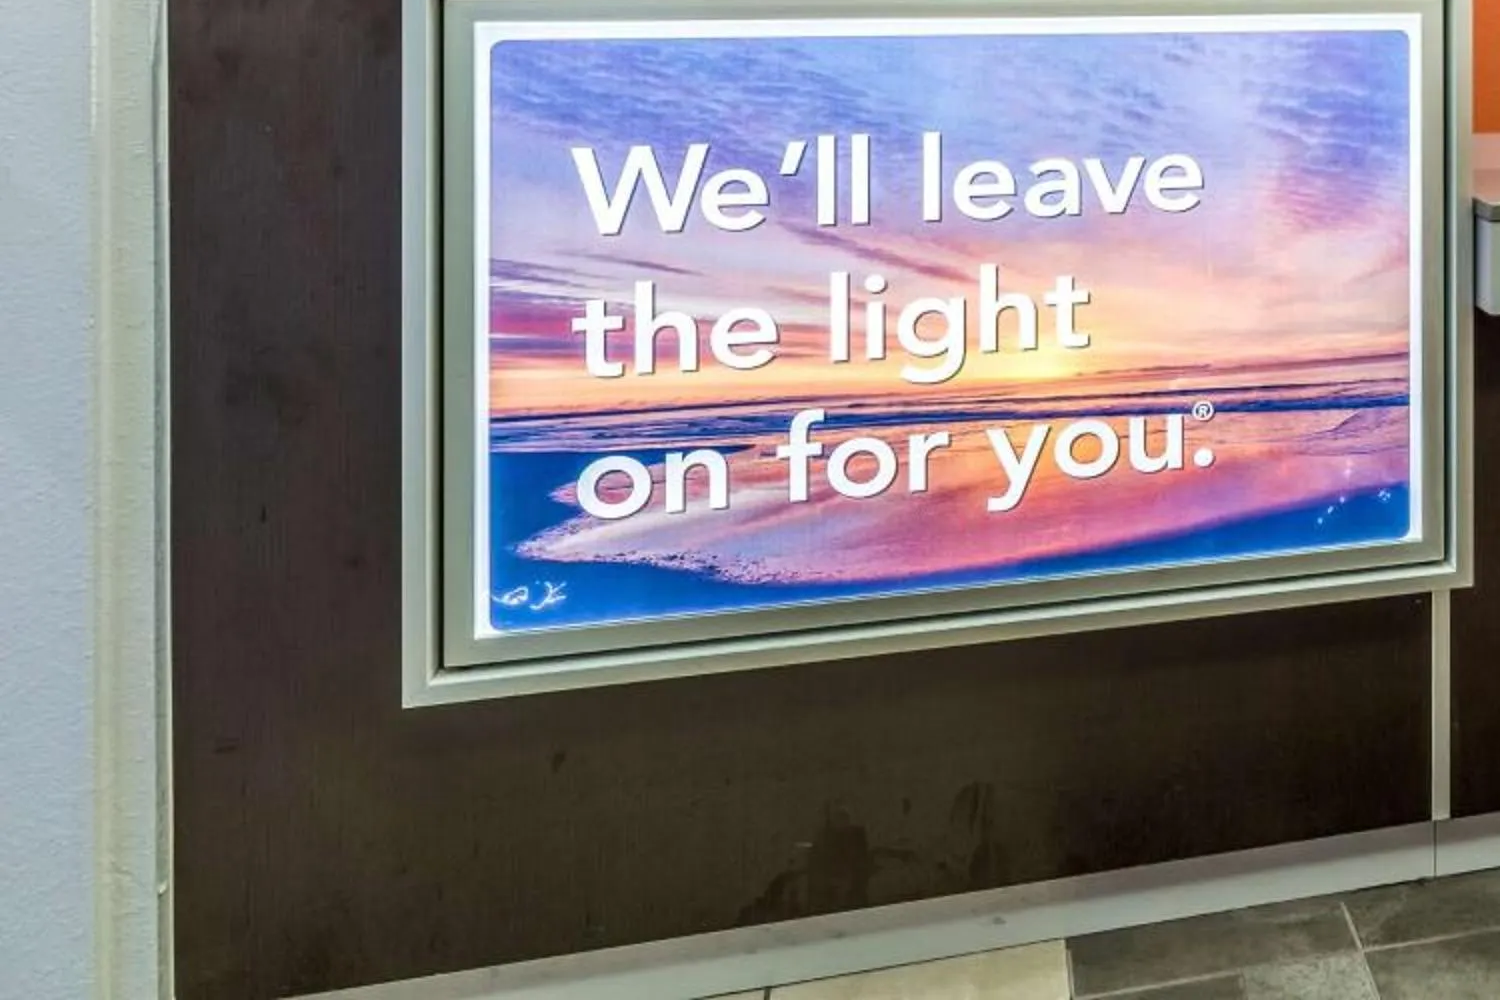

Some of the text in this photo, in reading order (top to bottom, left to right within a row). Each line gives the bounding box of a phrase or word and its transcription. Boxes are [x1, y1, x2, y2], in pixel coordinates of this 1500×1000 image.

[571, 131, 1204, 236] We'll leave
[571, 264, 1091, 384] the light
[576, 449, 730, 520] on
[775, 408, 951, 503] for
